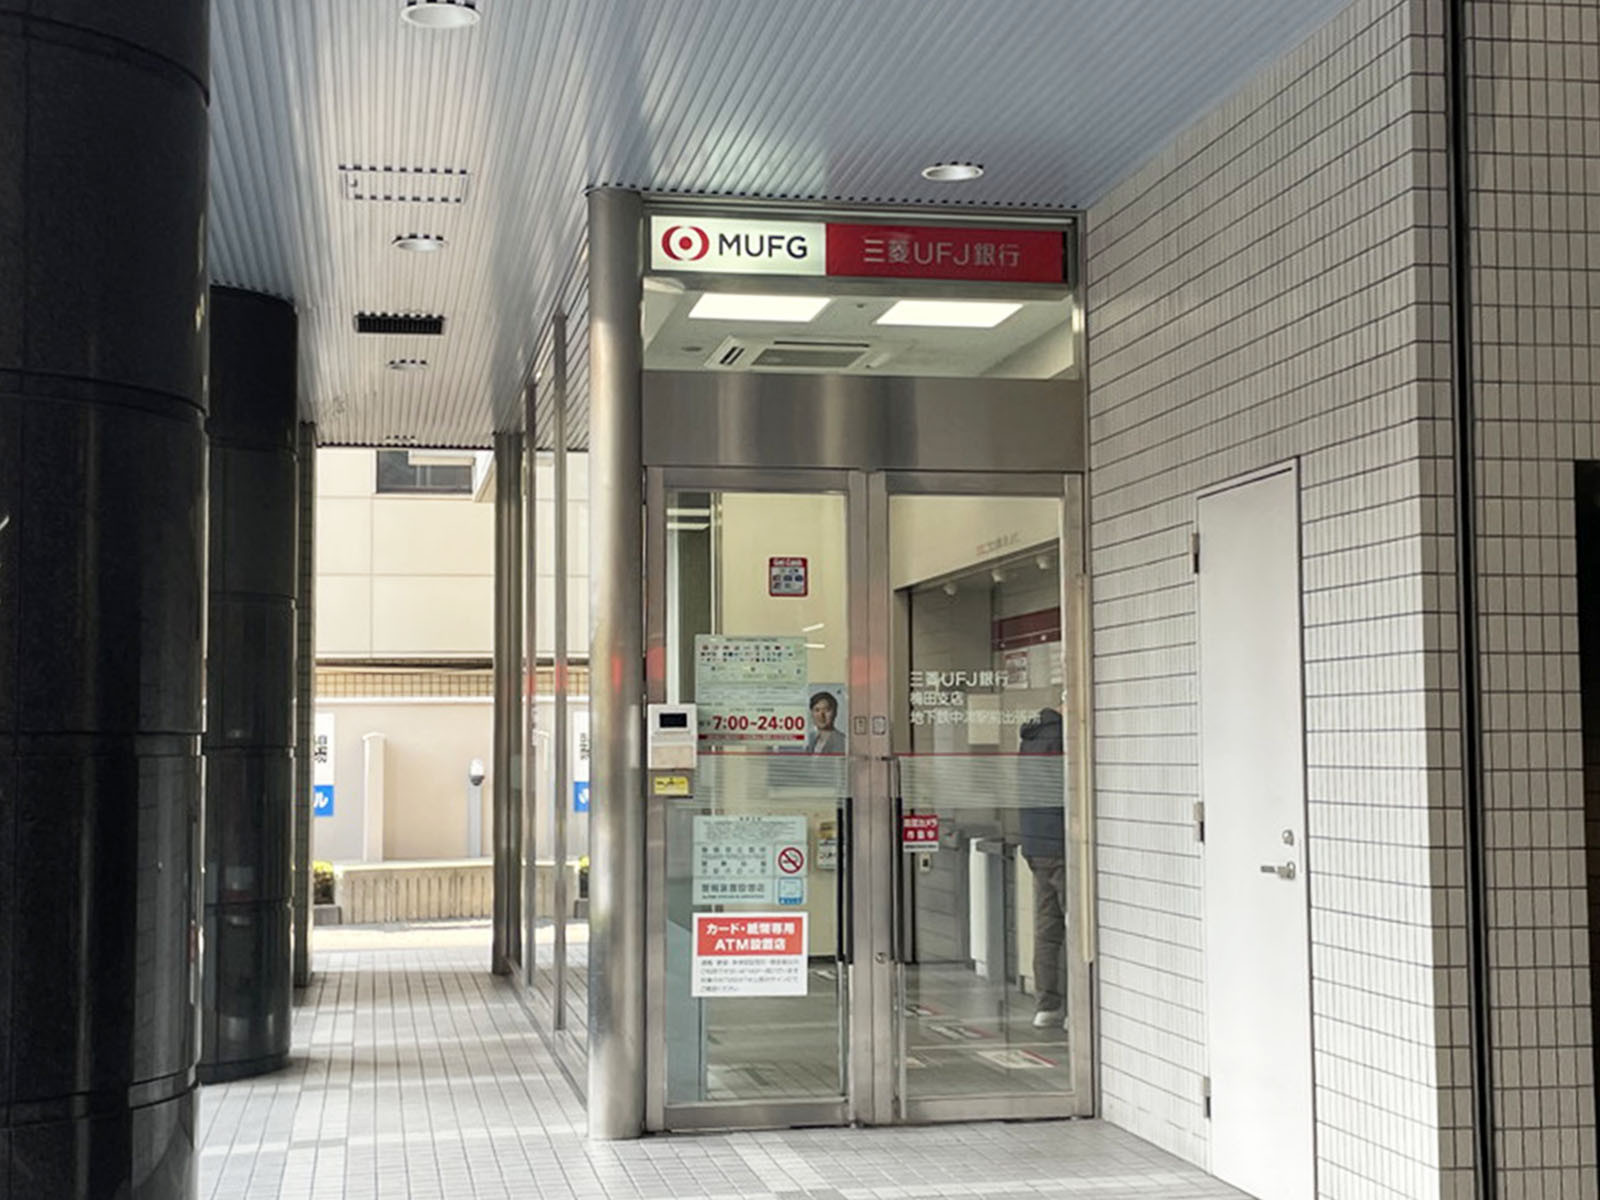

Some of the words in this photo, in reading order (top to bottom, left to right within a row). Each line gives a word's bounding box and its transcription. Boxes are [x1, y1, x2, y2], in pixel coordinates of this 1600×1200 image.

[718, 232, 808, 260] MUFG
[863, 238, 1021, 267] 三菱UFJ銀行
[910, 671, 1009, 688] 三菱UFJ銀行
